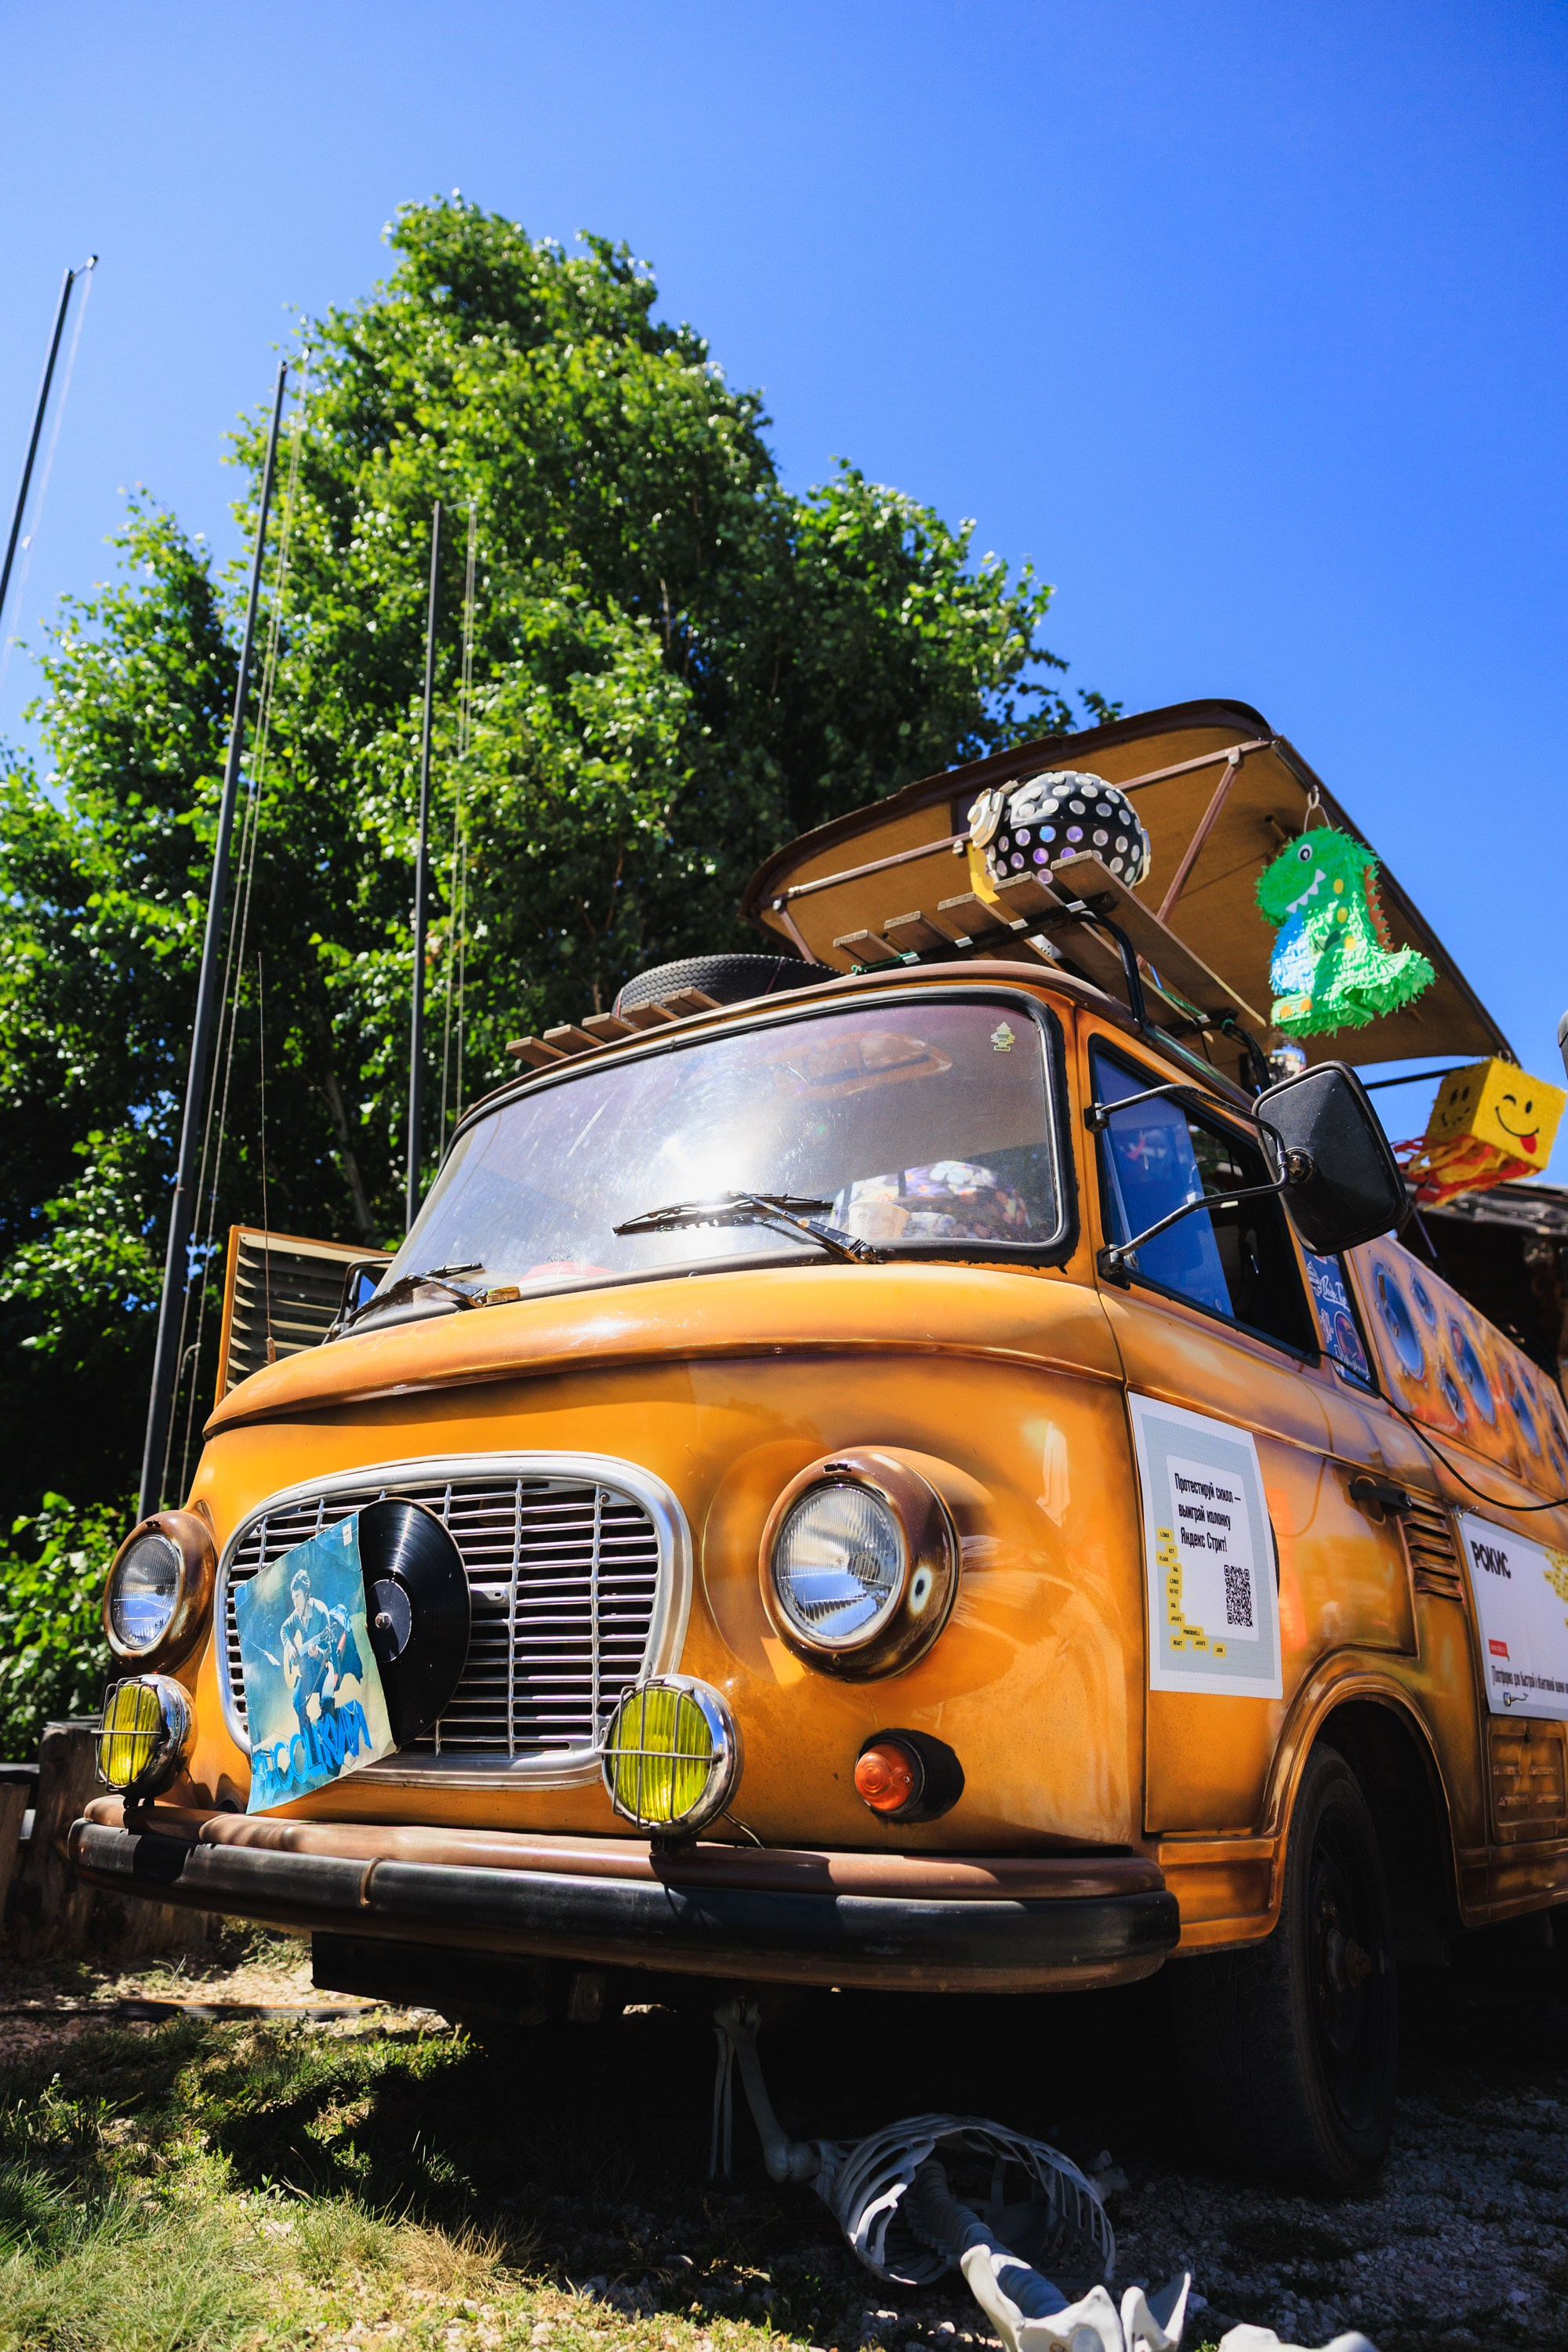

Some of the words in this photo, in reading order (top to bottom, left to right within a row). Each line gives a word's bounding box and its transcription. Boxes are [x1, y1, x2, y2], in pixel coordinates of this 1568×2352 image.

[1174, 1472, 1215, 1501] Протестируй
[1215, 1486, 1234, 1504] скилл
[1178, 1504, 1206, 1523] выиграй
[1207, 1510, 1231, 1531] колонку
[1181, 1526, 1206, 1548] Яндекс
[1207, 1532, 1228, 1554] Стрит!
[1470, 1540, 1512, 1580] РОКИС
